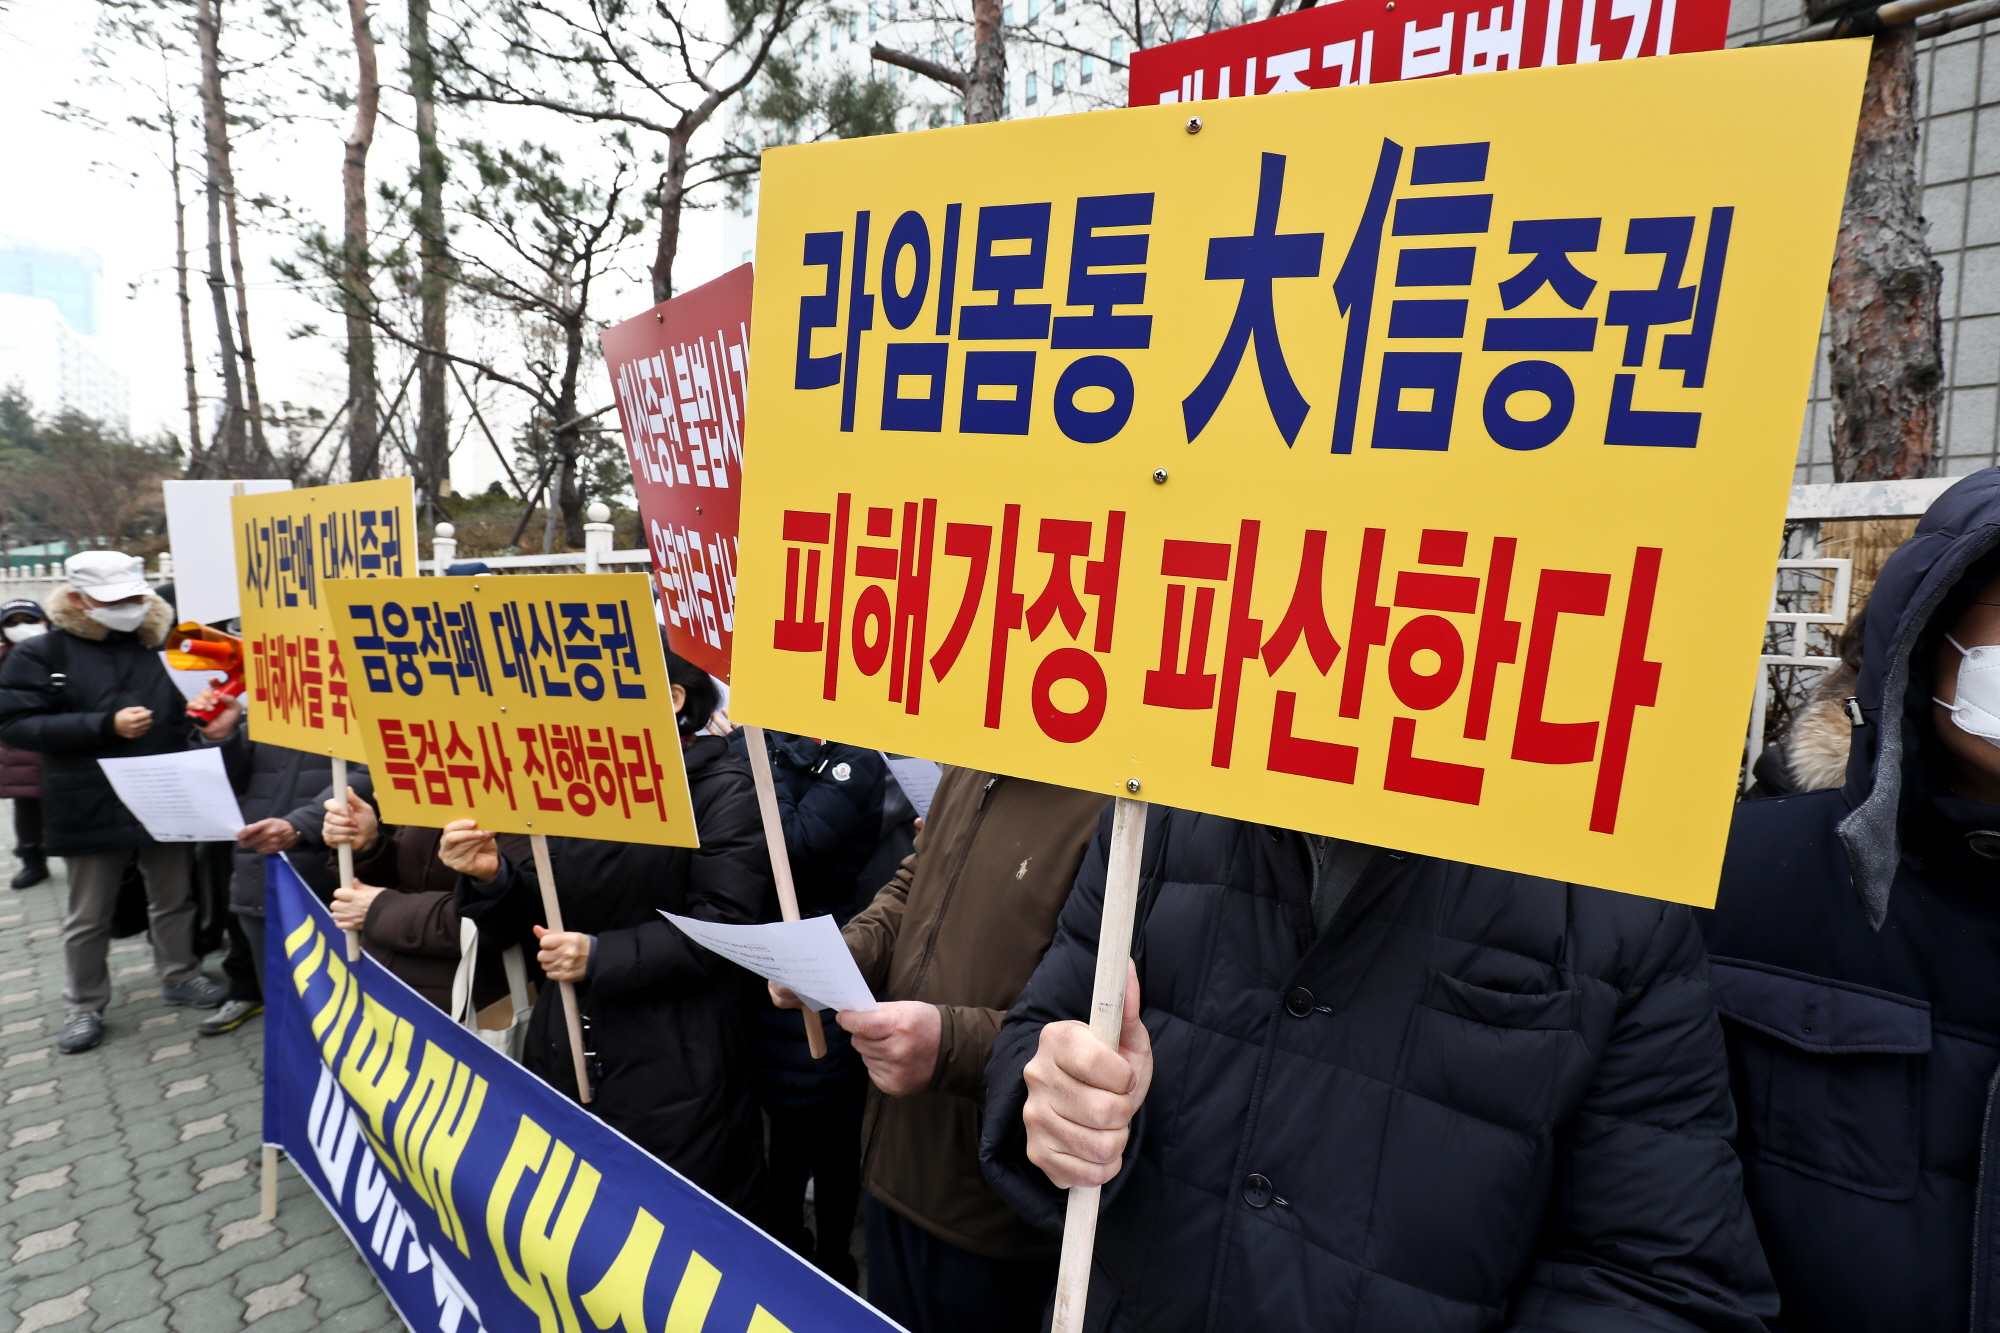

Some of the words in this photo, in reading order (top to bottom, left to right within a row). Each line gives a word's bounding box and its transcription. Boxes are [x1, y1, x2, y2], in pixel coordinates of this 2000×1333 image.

[795, 192, 1155, 444] 라임몸통
[1182, 137, 1735, 455] 大信증권
[617, 349, 690, 488] 대신증권
[245, 512, 317, 609] 사기판매
[252, 633, 324, 729] 피해자들
[328, 639, 357, 735] 죽
[349, 601, 494, 697] 금융적폐
[489, 600, 647, 701] 대신증권
[774, 492, 1126, 743] 피해가정
[1143, 519, 1663, 834] 파산한다
[377, 719, 517, 811] 특검수사
[516, 724, 668, 822] 진행하라
